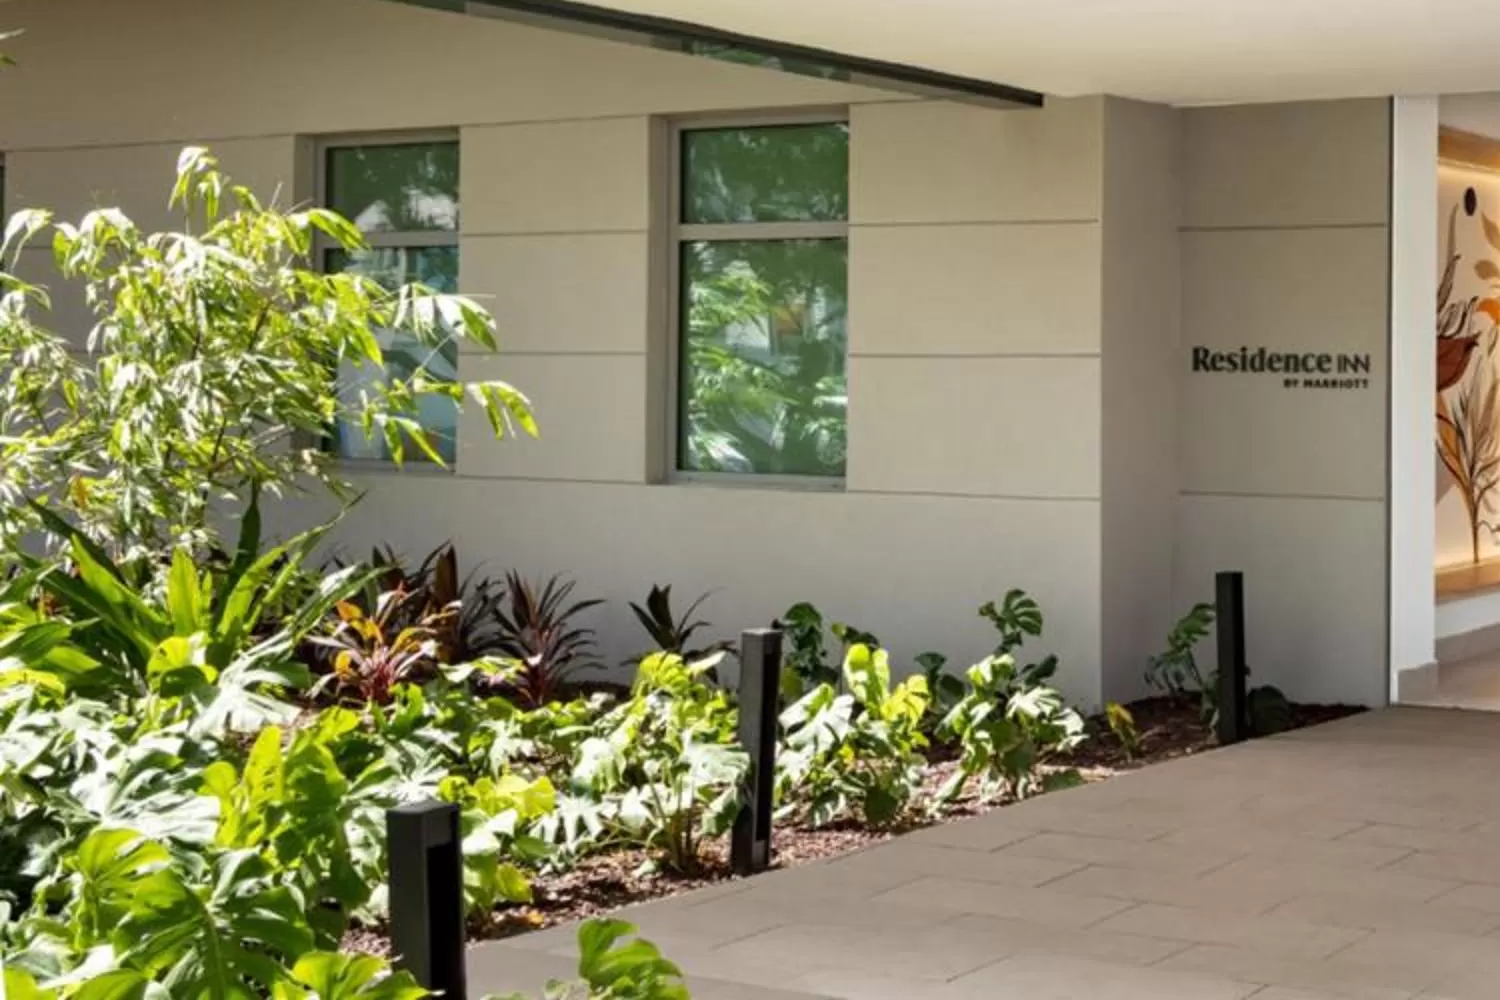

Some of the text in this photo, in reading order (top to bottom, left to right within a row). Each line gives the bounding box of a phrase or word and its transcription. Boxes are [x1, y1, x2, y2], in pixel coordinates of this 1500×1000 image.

[1191, 346, 1370, 374] Residence INN
[1283, 378, 1369, 390] BY MARRIOTT
